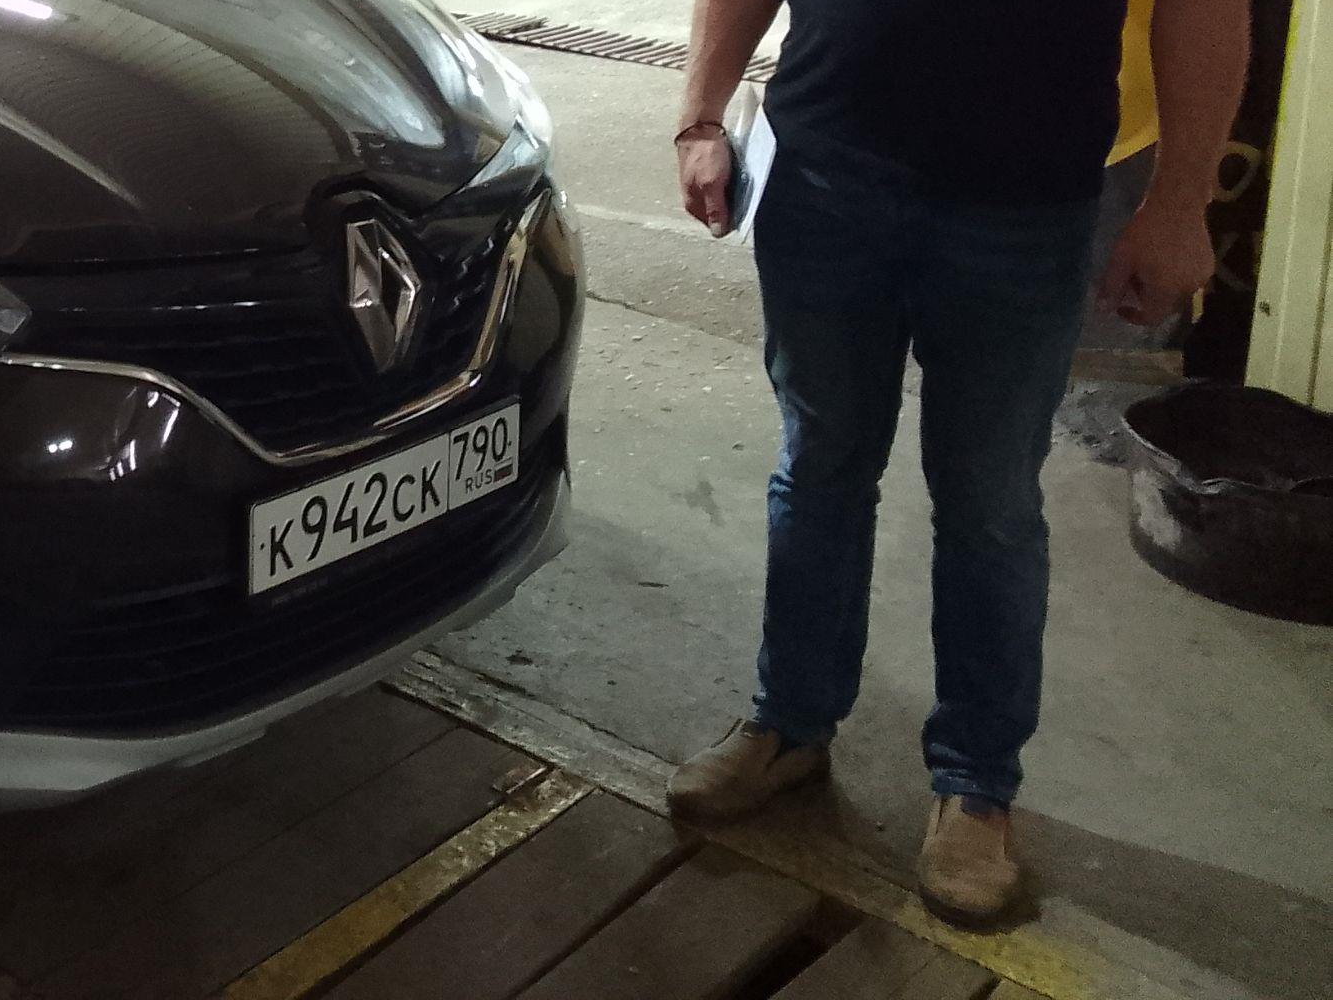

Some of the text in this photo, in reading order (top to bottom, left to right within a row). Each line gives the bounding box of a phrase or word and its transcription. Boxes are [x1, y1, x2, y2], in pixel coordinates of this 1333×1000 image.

[269, 417, 508, 577] К942СК 790
[465, 468, 494, 495] RUS
